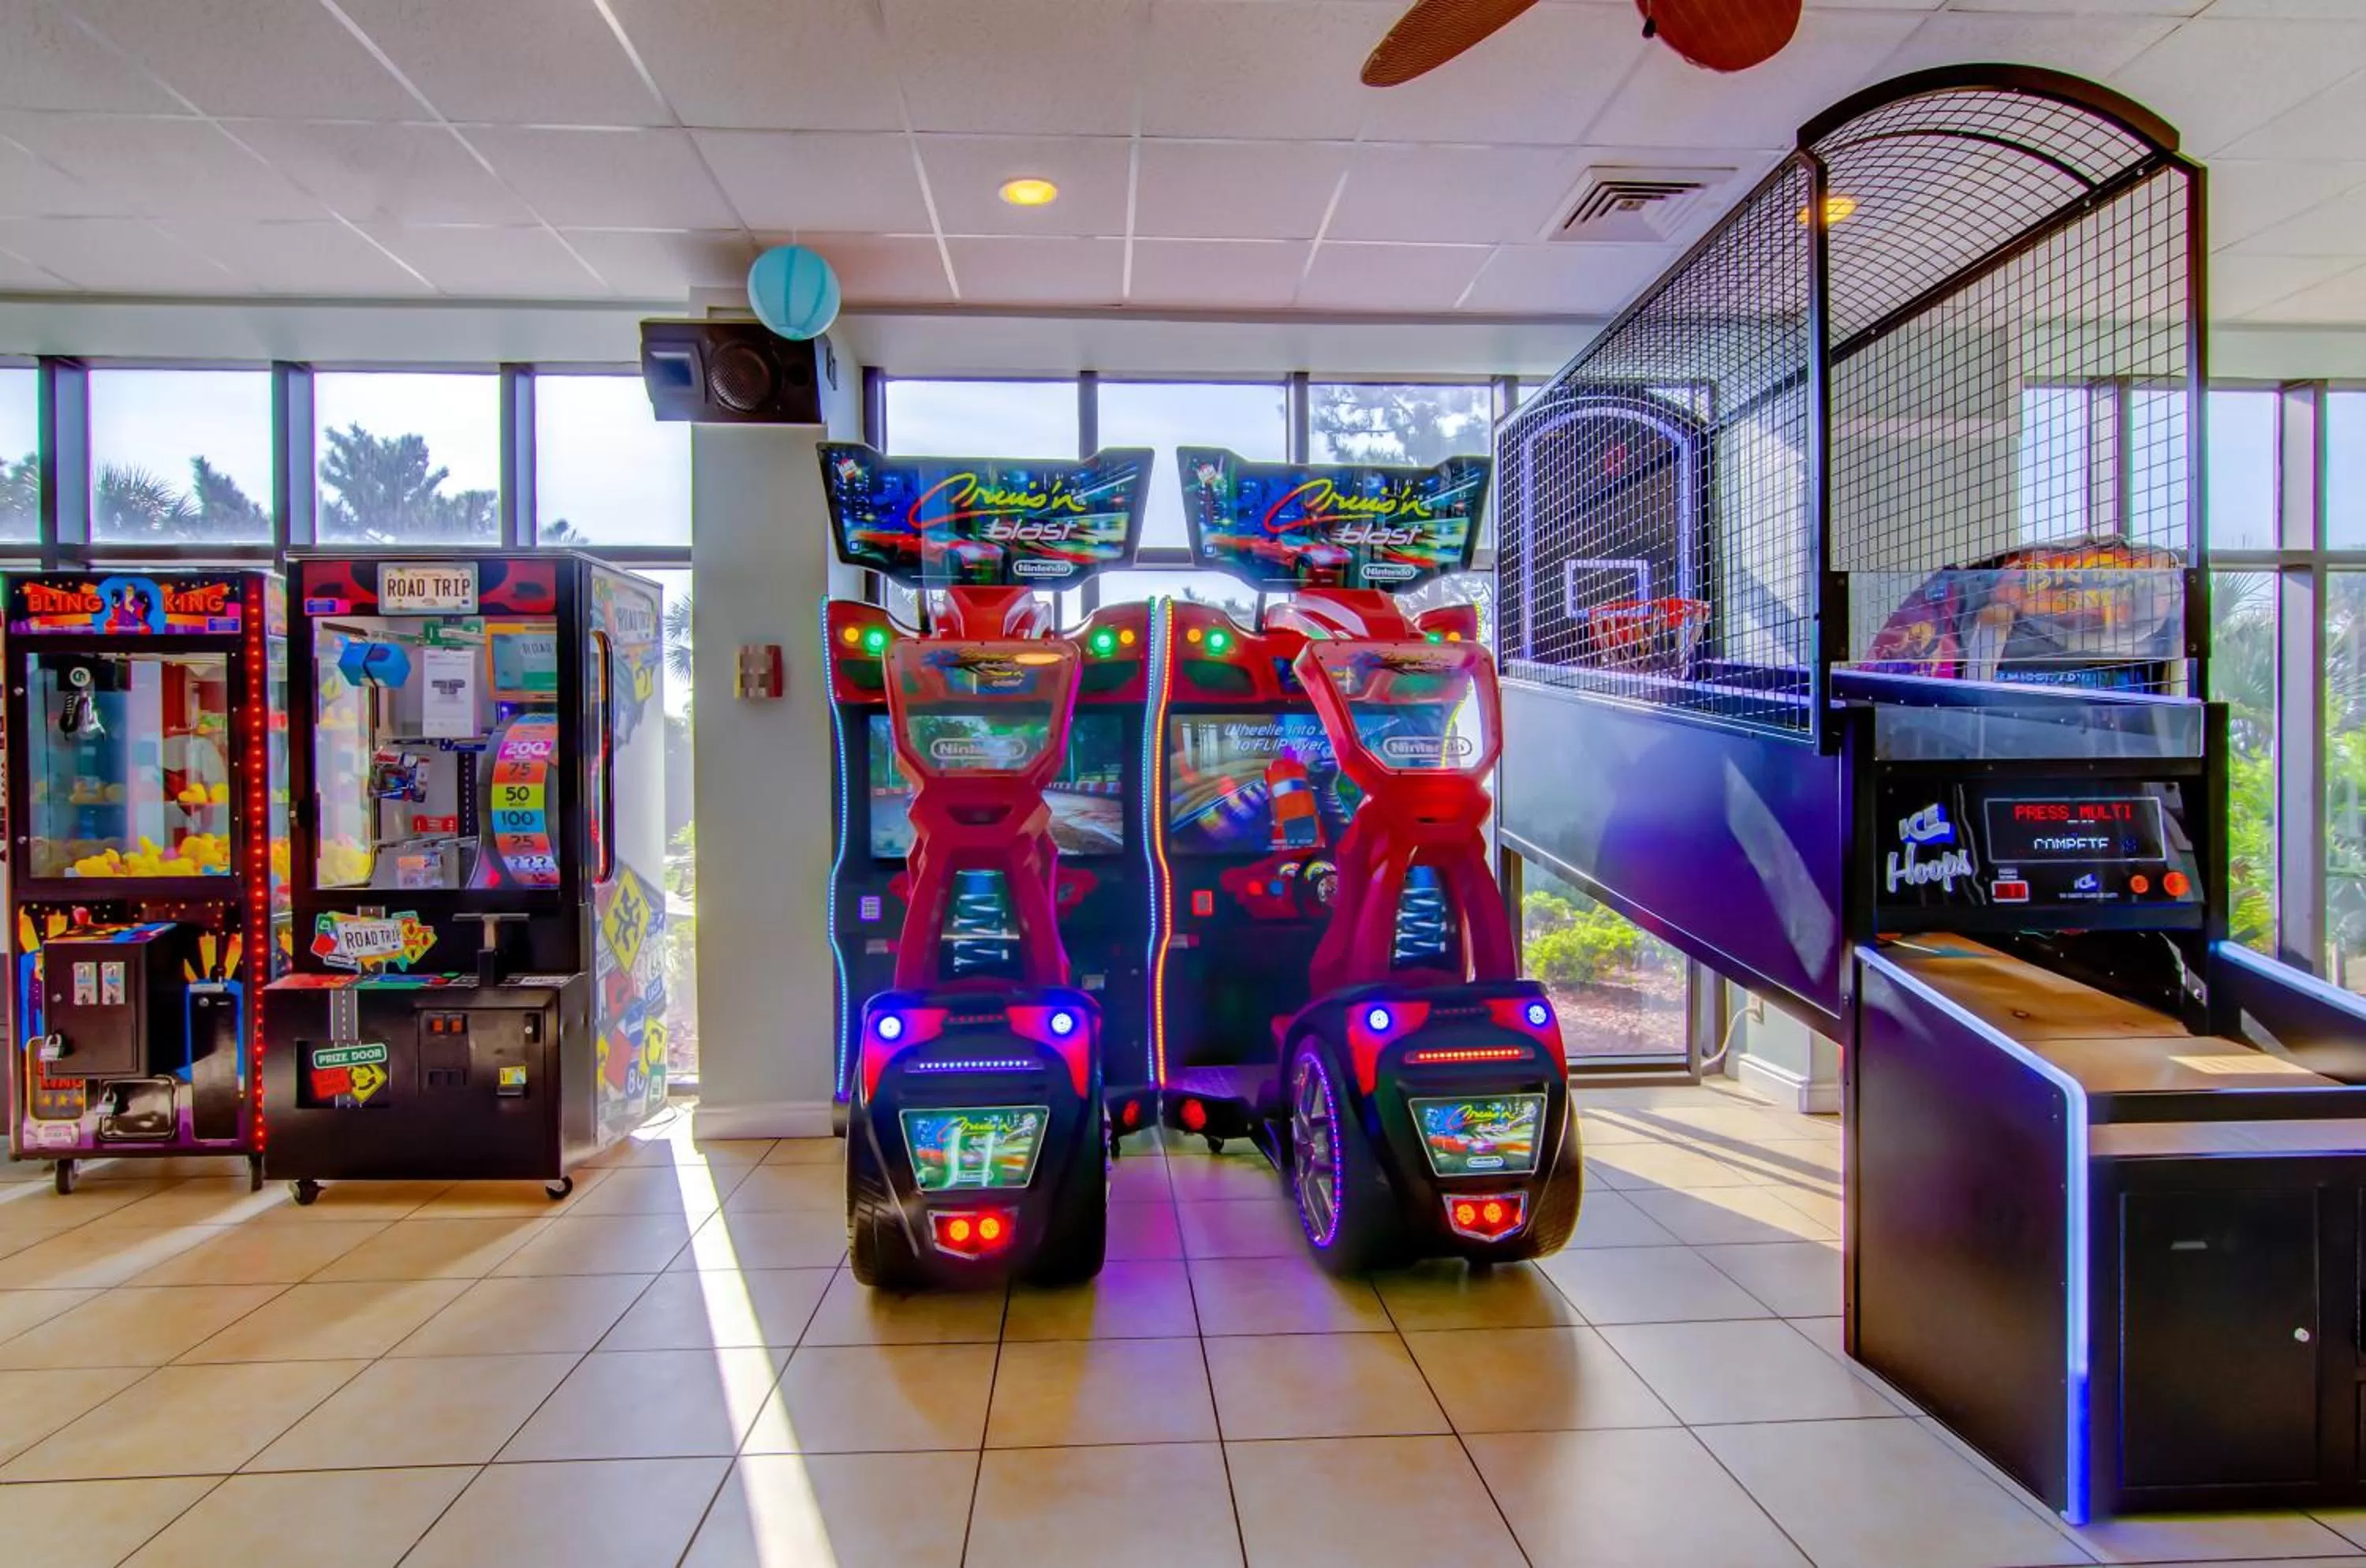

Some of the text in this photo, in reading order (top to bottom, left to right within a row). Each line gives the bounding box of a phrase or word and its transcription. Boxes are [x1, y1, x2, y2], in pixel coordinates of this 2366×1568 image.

[908, 472, 1085, 529] Cruis'n
[1263, 479, 1431, 533] Cruis'n
[984, 517, 1078, 541] blast
[1331, 522, 1423, 545] blast
[1366, 567, 1411, 576] Nintendo
[387, 578, 471, 597] ROAD TRIP
[28, 593, 225, 612] BLING KING
[1224, 722, 1284, 736] Wheelie
[1253, 738, 1288, 752] FLIP
[509, 762, 531, 777] 75
[506, 786, 530, 801] 50
[502, 811, 535, 826] 100
[2014, 803, 2133, 821] PRESS MULTI
[1898, 802, 1950, 842] ICE
[1886, 842, 1972, 893] Hoops
[345, 931, 379, 950] ROAD
[319, 1049, 382, 1064] PRIZE DOOR
